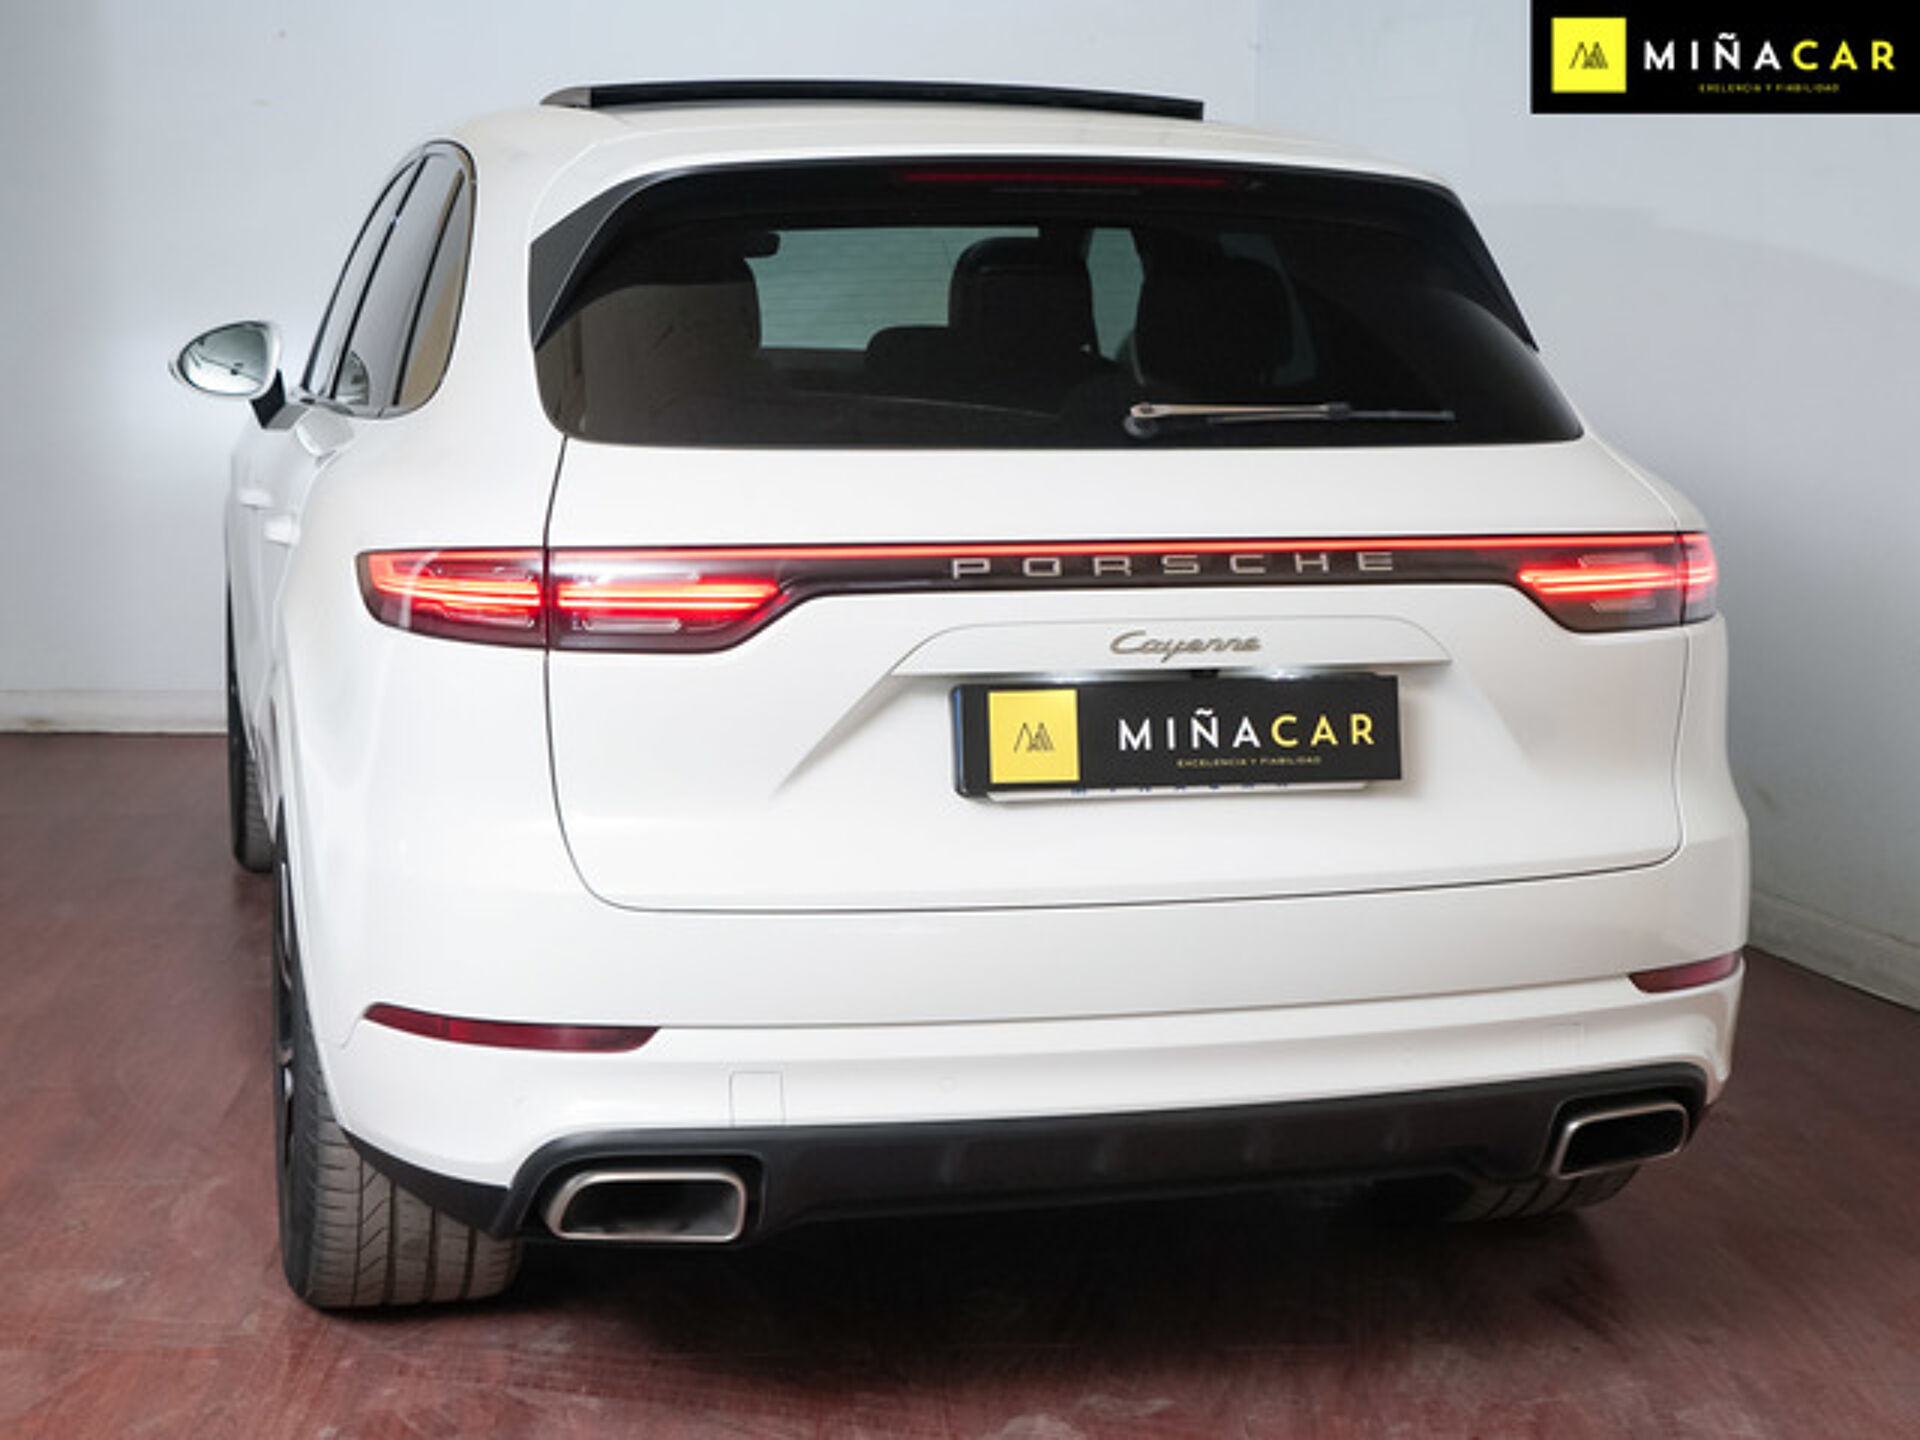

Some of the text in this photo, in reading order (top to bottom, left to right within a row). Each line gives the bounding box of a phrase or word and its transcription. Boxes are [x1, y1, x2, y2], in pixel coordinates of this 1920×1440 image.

[952, 551, 1394, 579] PORSCHE
[1110, 630, 1261, 663] Cayenne
[1118, 708, 1375, 751] MIÑACAR
